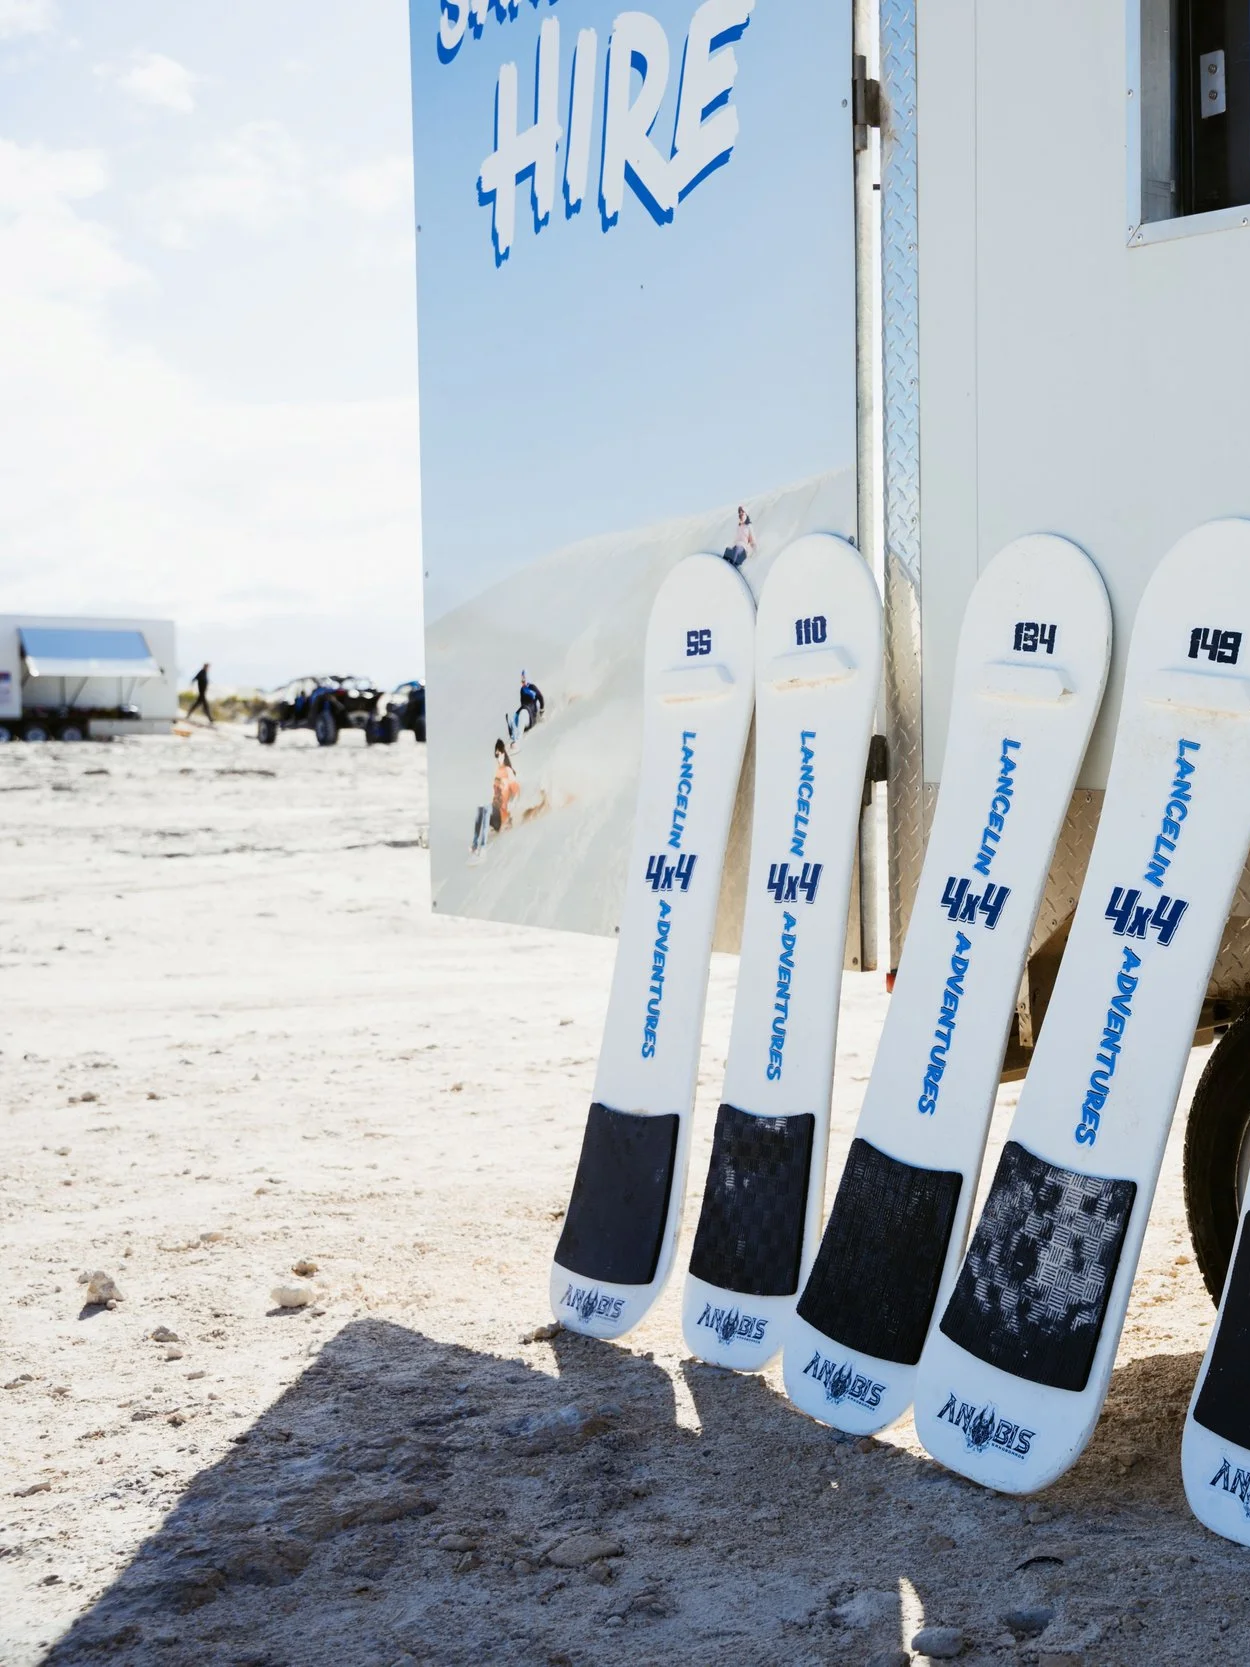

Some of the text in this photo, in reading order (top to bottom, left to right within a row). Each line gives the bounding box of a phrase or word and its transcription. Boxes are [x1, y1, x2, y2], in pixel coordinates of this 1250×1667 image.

[477, 0, 755, 268] HIRE
[687, 629, 711, 656] 55
[795, 616, 827, 645] 110
[1013, 622, 1057, 654] 134
[1188, 627, 1242, 665] 149
[668, 730, 696, 849] LANCELIN
[790, 730, 816, 857] LANCELIN
[973, 738, 1022, 876] LANCELIN
[1144, 738, 1201, 888] LANCELIN
[646, 853, 698, 892] 4x4
[767, 862, 824, 904] 4x4
[940, 876, 1011, 930] 4x4
[1104, 886, 1190, 947] 4x4
[641, 900, 672, 1059] ADVENTURES
[766, 912, 797, 1081] ADVENTURES
[917, 931, 972, 1116] ADVENTURES
[1075, 946, 1144, 1147] ADVENTURES
